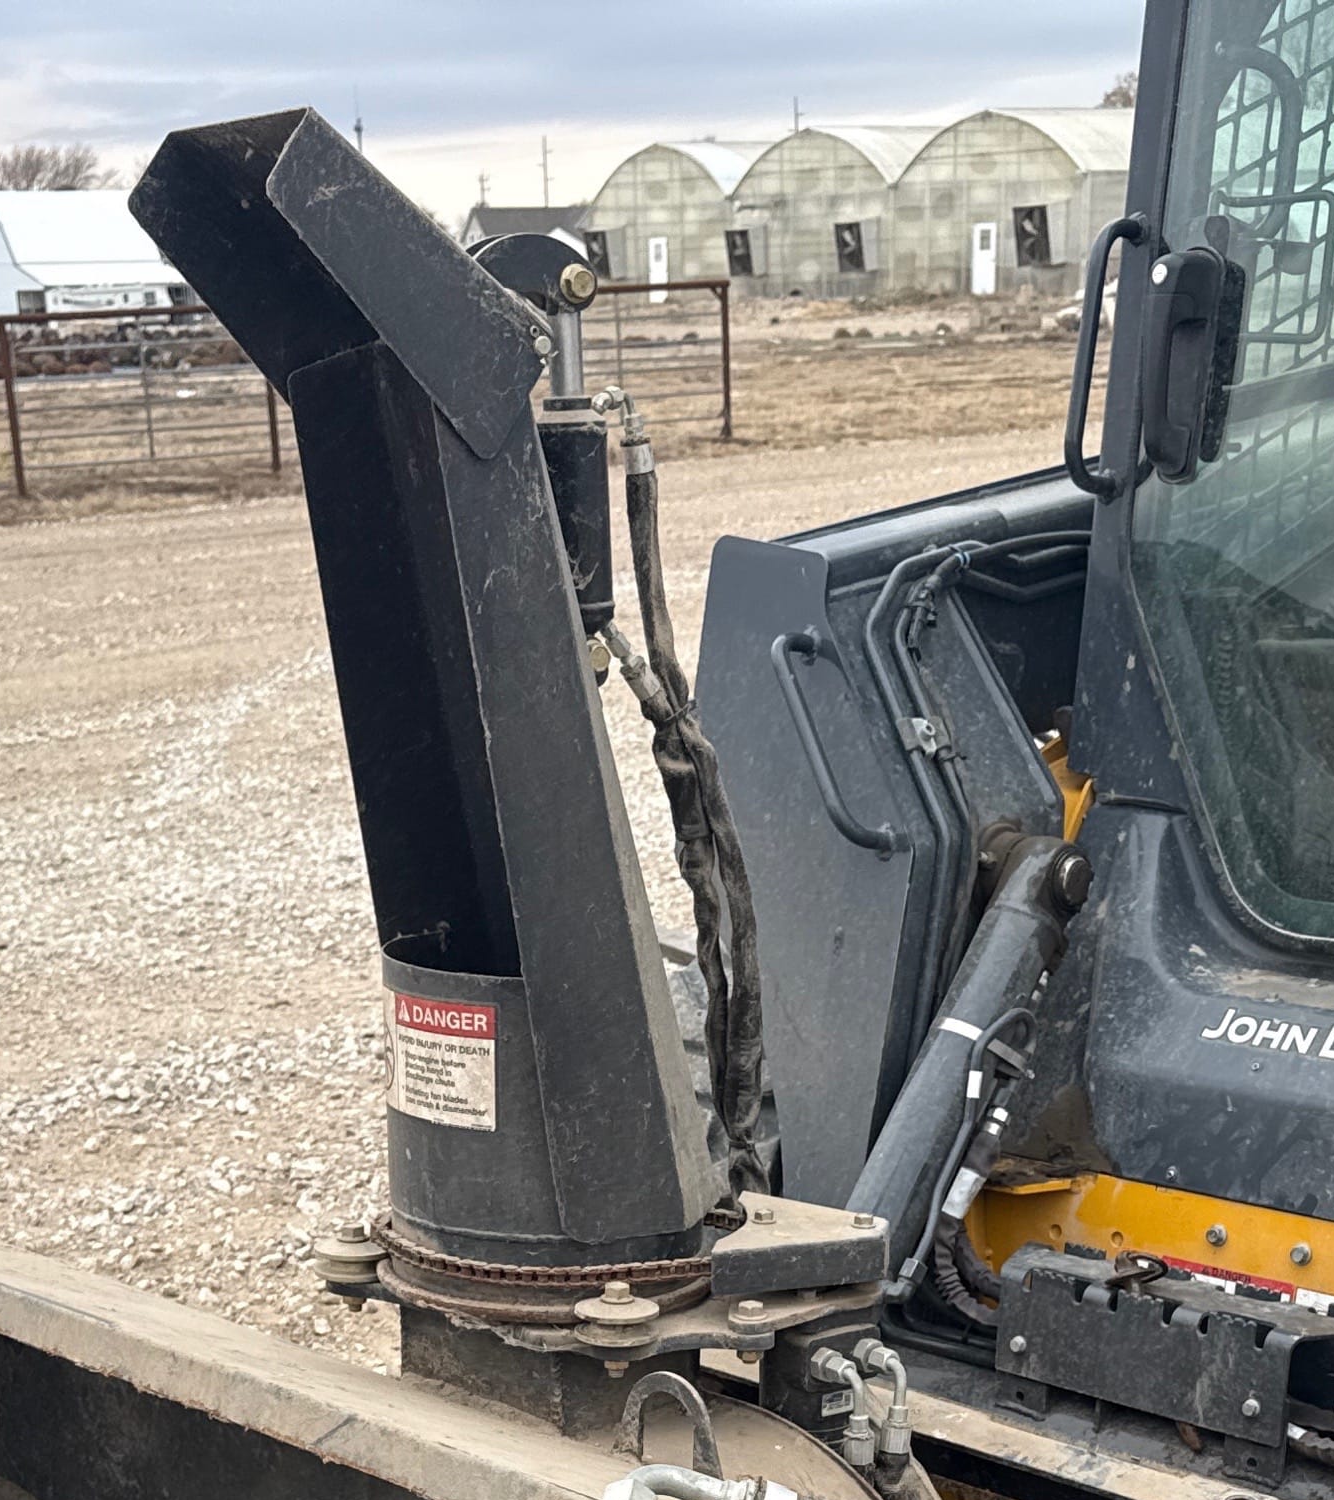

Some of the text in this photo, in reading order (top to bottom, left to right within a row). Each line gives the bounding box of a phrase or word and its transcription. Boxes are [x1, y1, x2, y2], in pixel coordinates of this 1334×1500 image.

[413, 1006, 488, 1032] DANGER
[1201, 1008, 1318, 1055] JOHN
[416, 1037, 442, 1051] INJURY
[445, 1043, 457, 1053] OR
[459, 1046, 490, 1057] DEATH
[1211, 1267, 1252, 1284] DANGER
